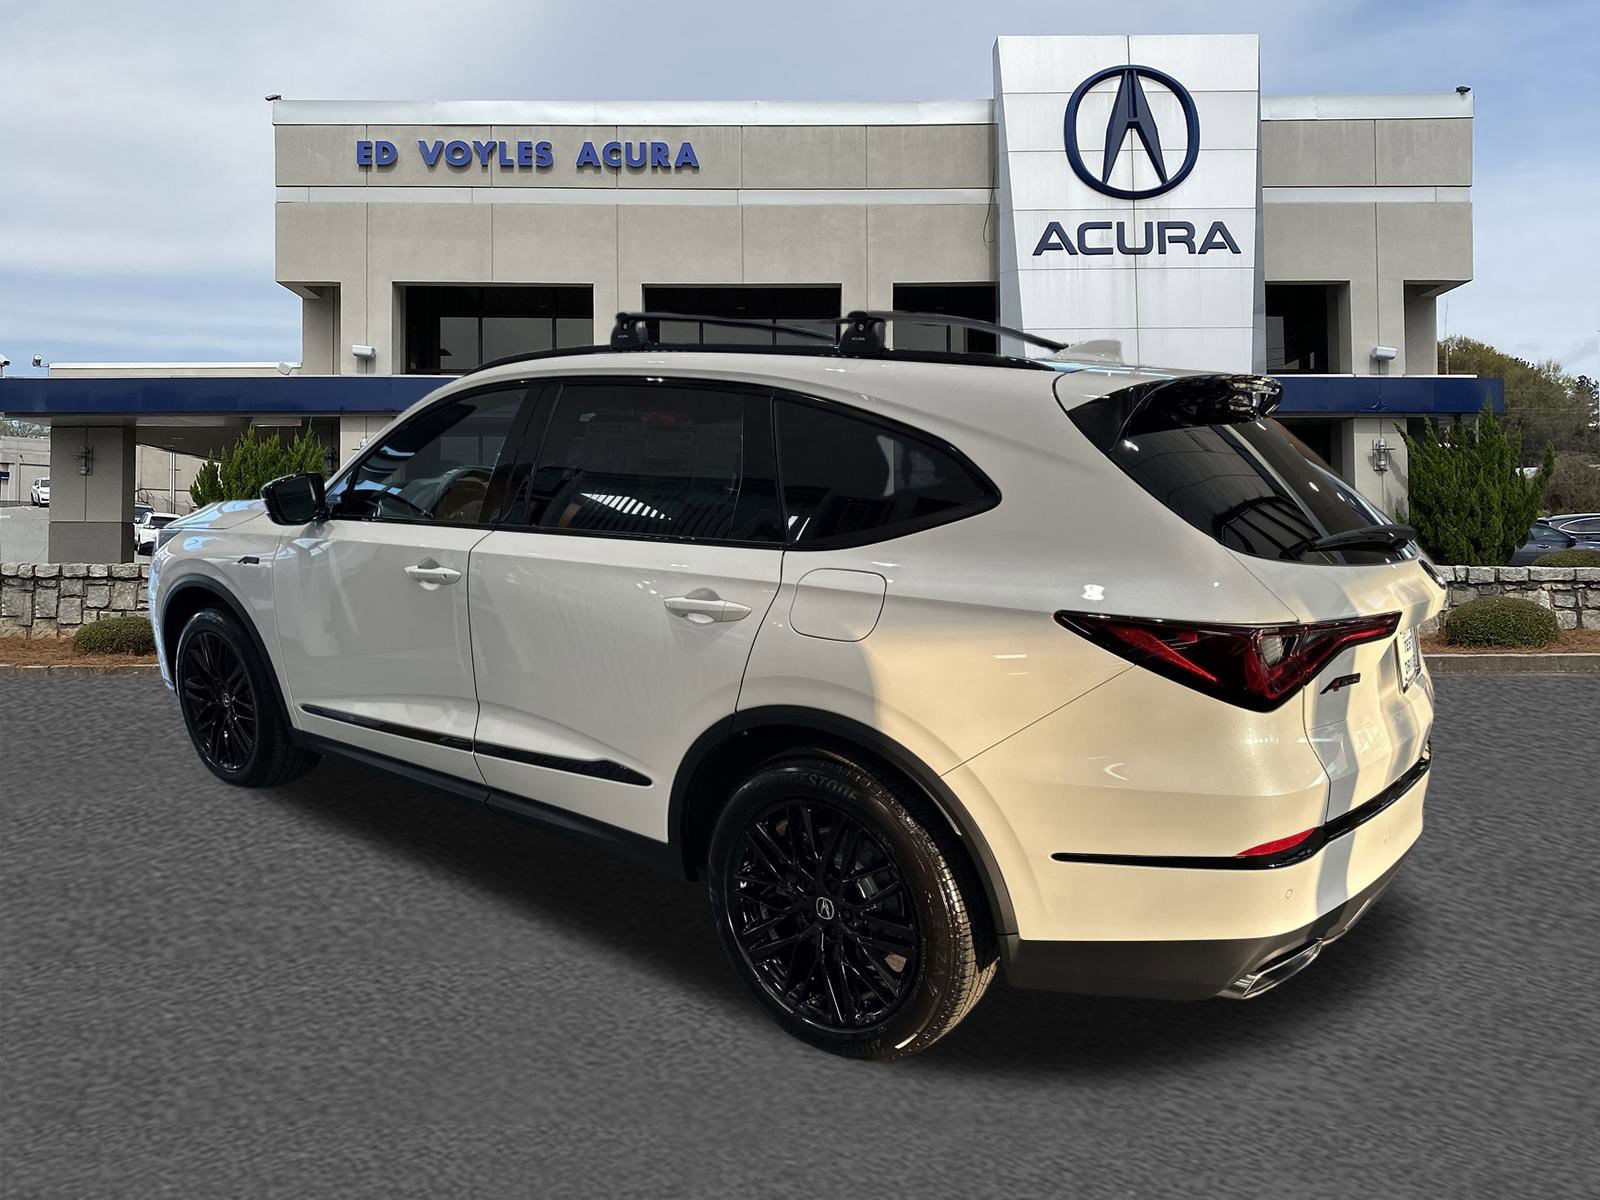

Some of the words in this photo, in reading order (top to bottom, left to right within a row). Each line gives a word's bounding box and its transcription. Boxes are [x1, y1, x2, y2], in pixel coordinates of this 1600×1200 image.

[356, 139, 398, 166] ED
[418, 140, 554, 167] VOYLES
[576, 141, 700, 168] ACURA
[1032, 221, 1241, 256] ACURA
